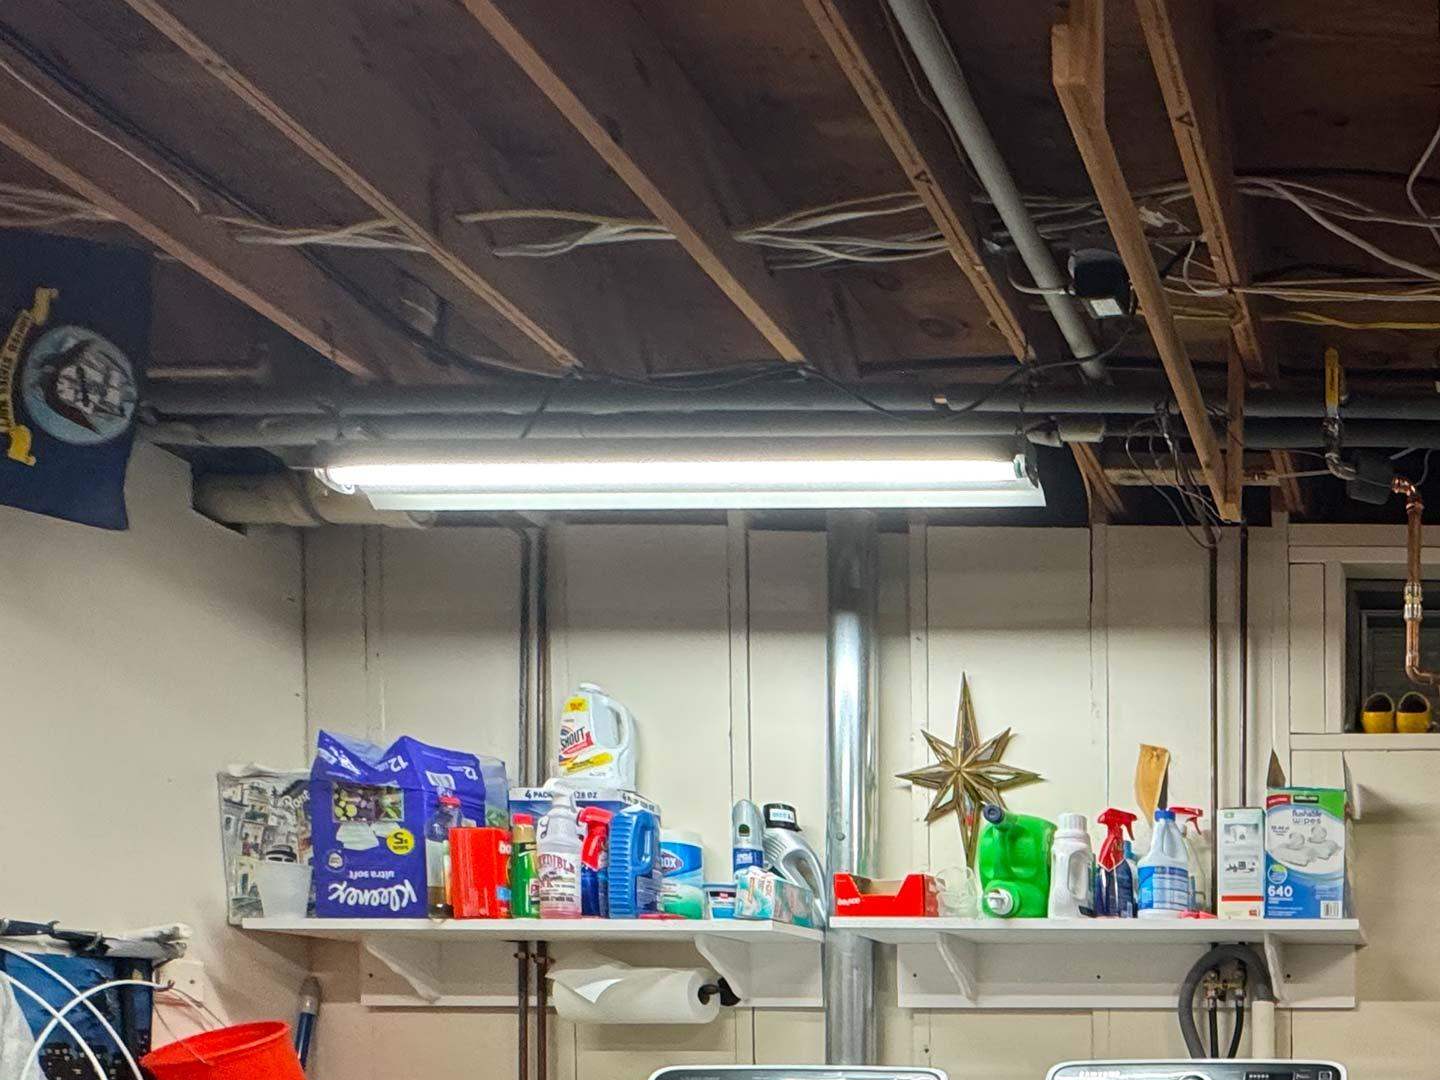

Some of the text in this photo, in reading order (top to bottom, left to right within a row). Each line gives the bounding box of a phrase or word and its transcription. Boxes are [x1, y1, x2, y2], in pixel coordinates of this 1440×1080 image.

[390, 756, 409, 773] 12
[525, 790, 532, 799] 4
[1291, 809, 1322, 817] flushable
[1292, 817, 1322, 825] wipes
[349, 869, 396, 880] ultra soft
[328, 879, 417, 911] Kleenex
[1268, 885, 1293, 897] 640
